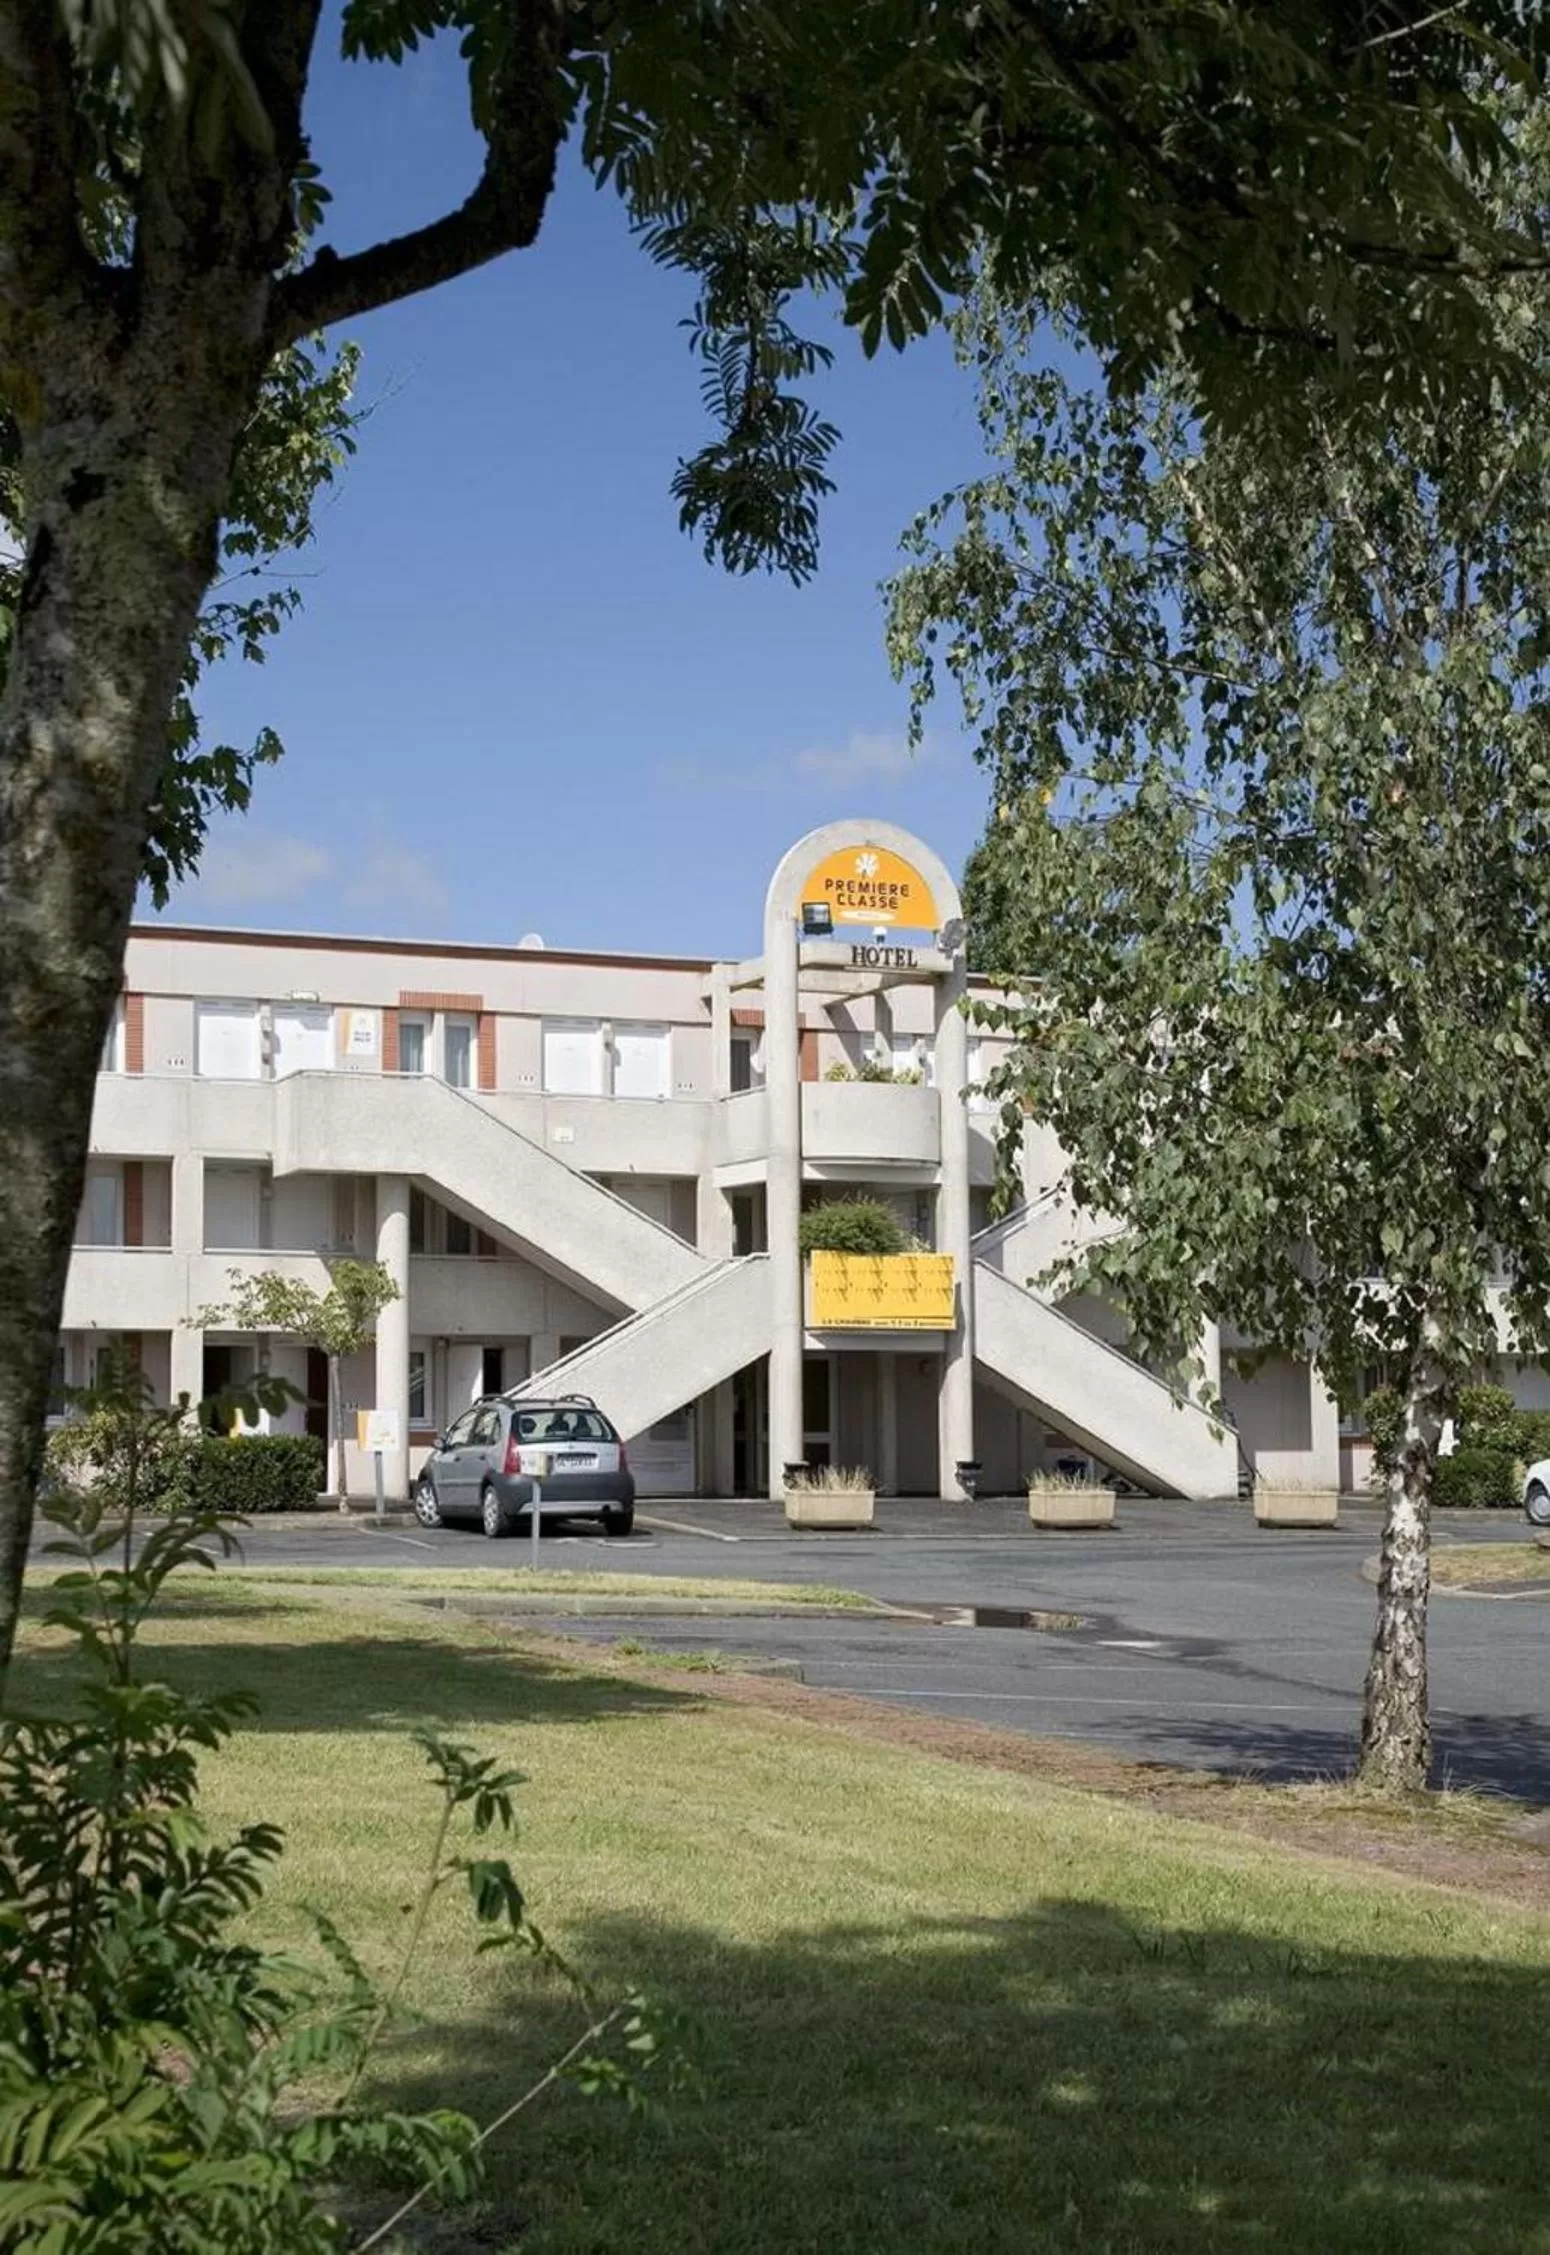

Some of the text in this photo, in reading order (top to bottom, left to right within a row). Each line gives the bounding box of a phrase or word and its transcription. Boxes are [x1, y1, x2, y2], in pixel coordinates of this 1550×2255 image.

[825, 879, 909, 897] PREMIERE
[837, 893, 898, 909] CLASSE
[852, 945, 918, 967] HOTEL
